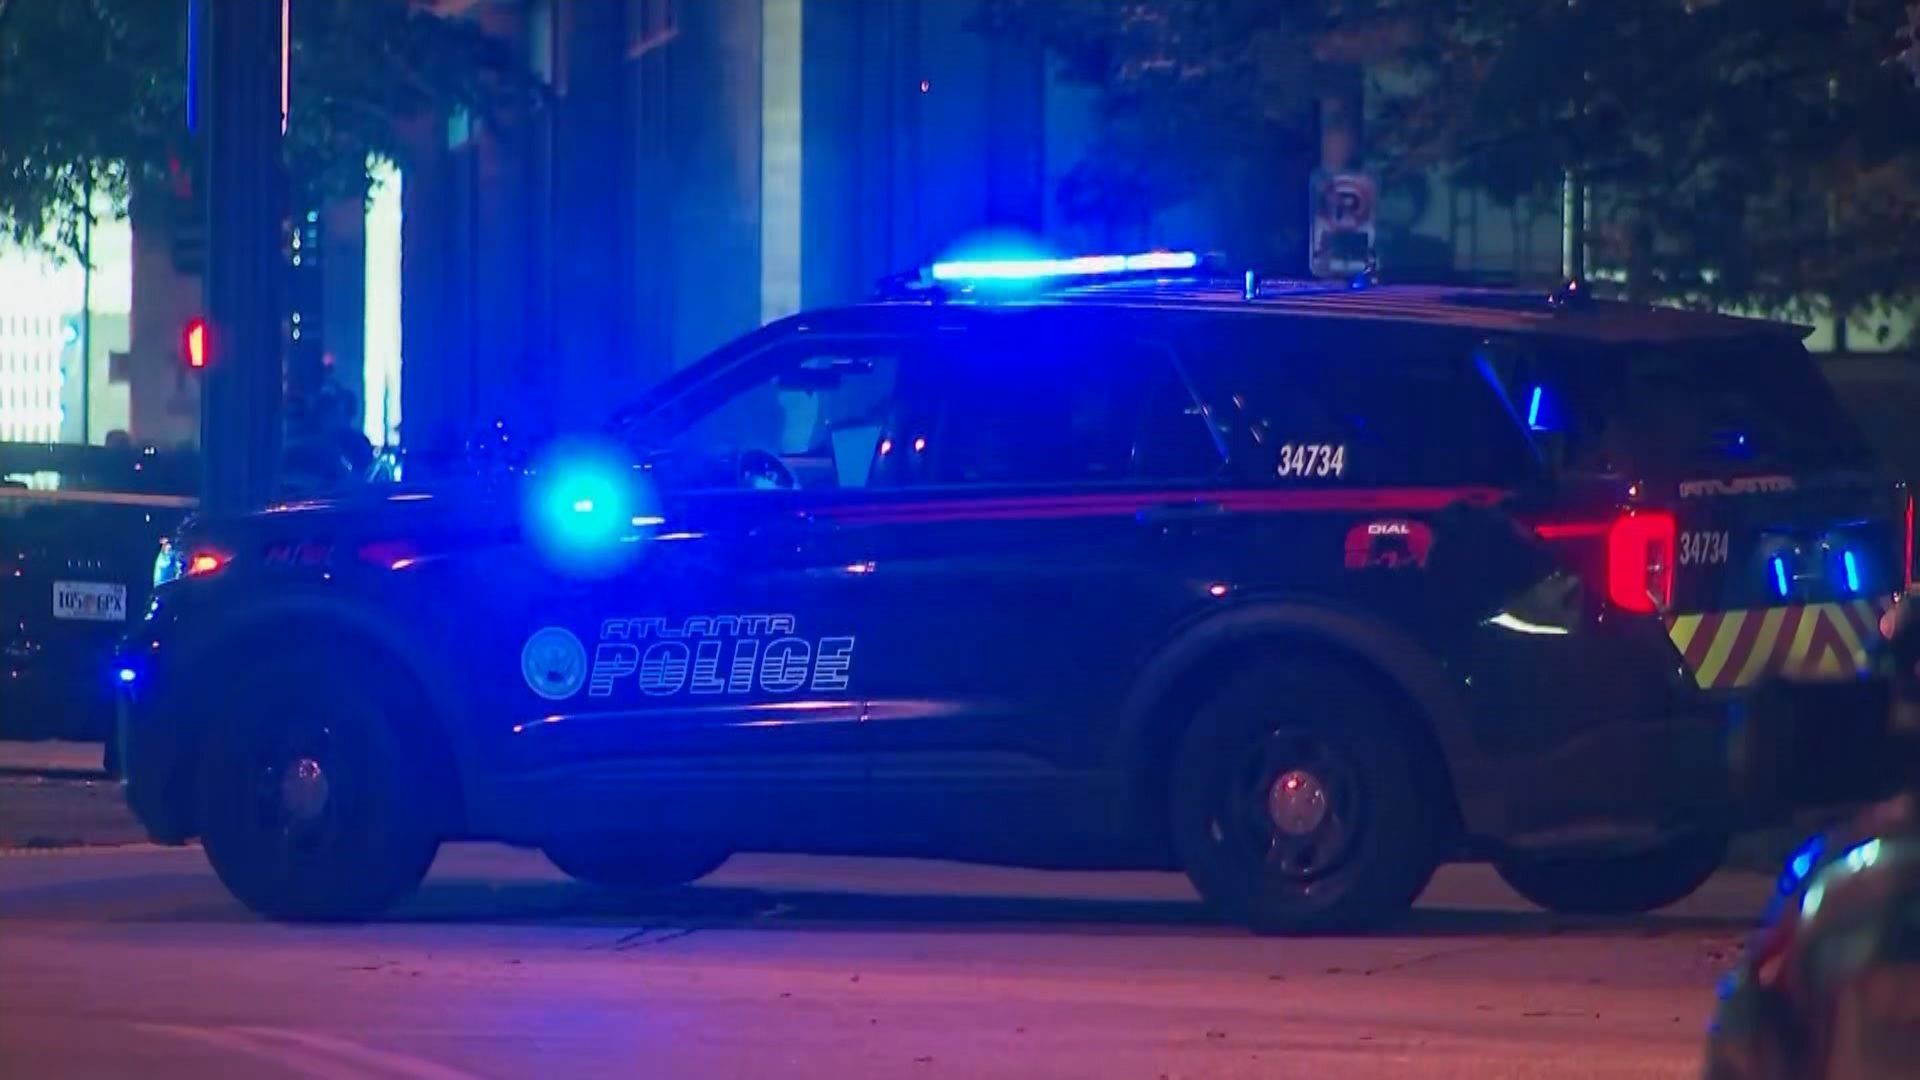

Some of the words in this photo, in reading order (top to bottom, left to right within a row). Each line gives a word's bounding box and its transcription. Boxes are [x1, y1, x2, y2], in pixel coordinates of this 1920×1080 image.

[1277, 443, 1345, 477] 34734
[1367, 523, 1411, 535] DIAL
[1679, 530, 1730, 566] 34734
[600, 613, 796, 640] ATLANTA
[588, 636, 855, 697] POLICE
